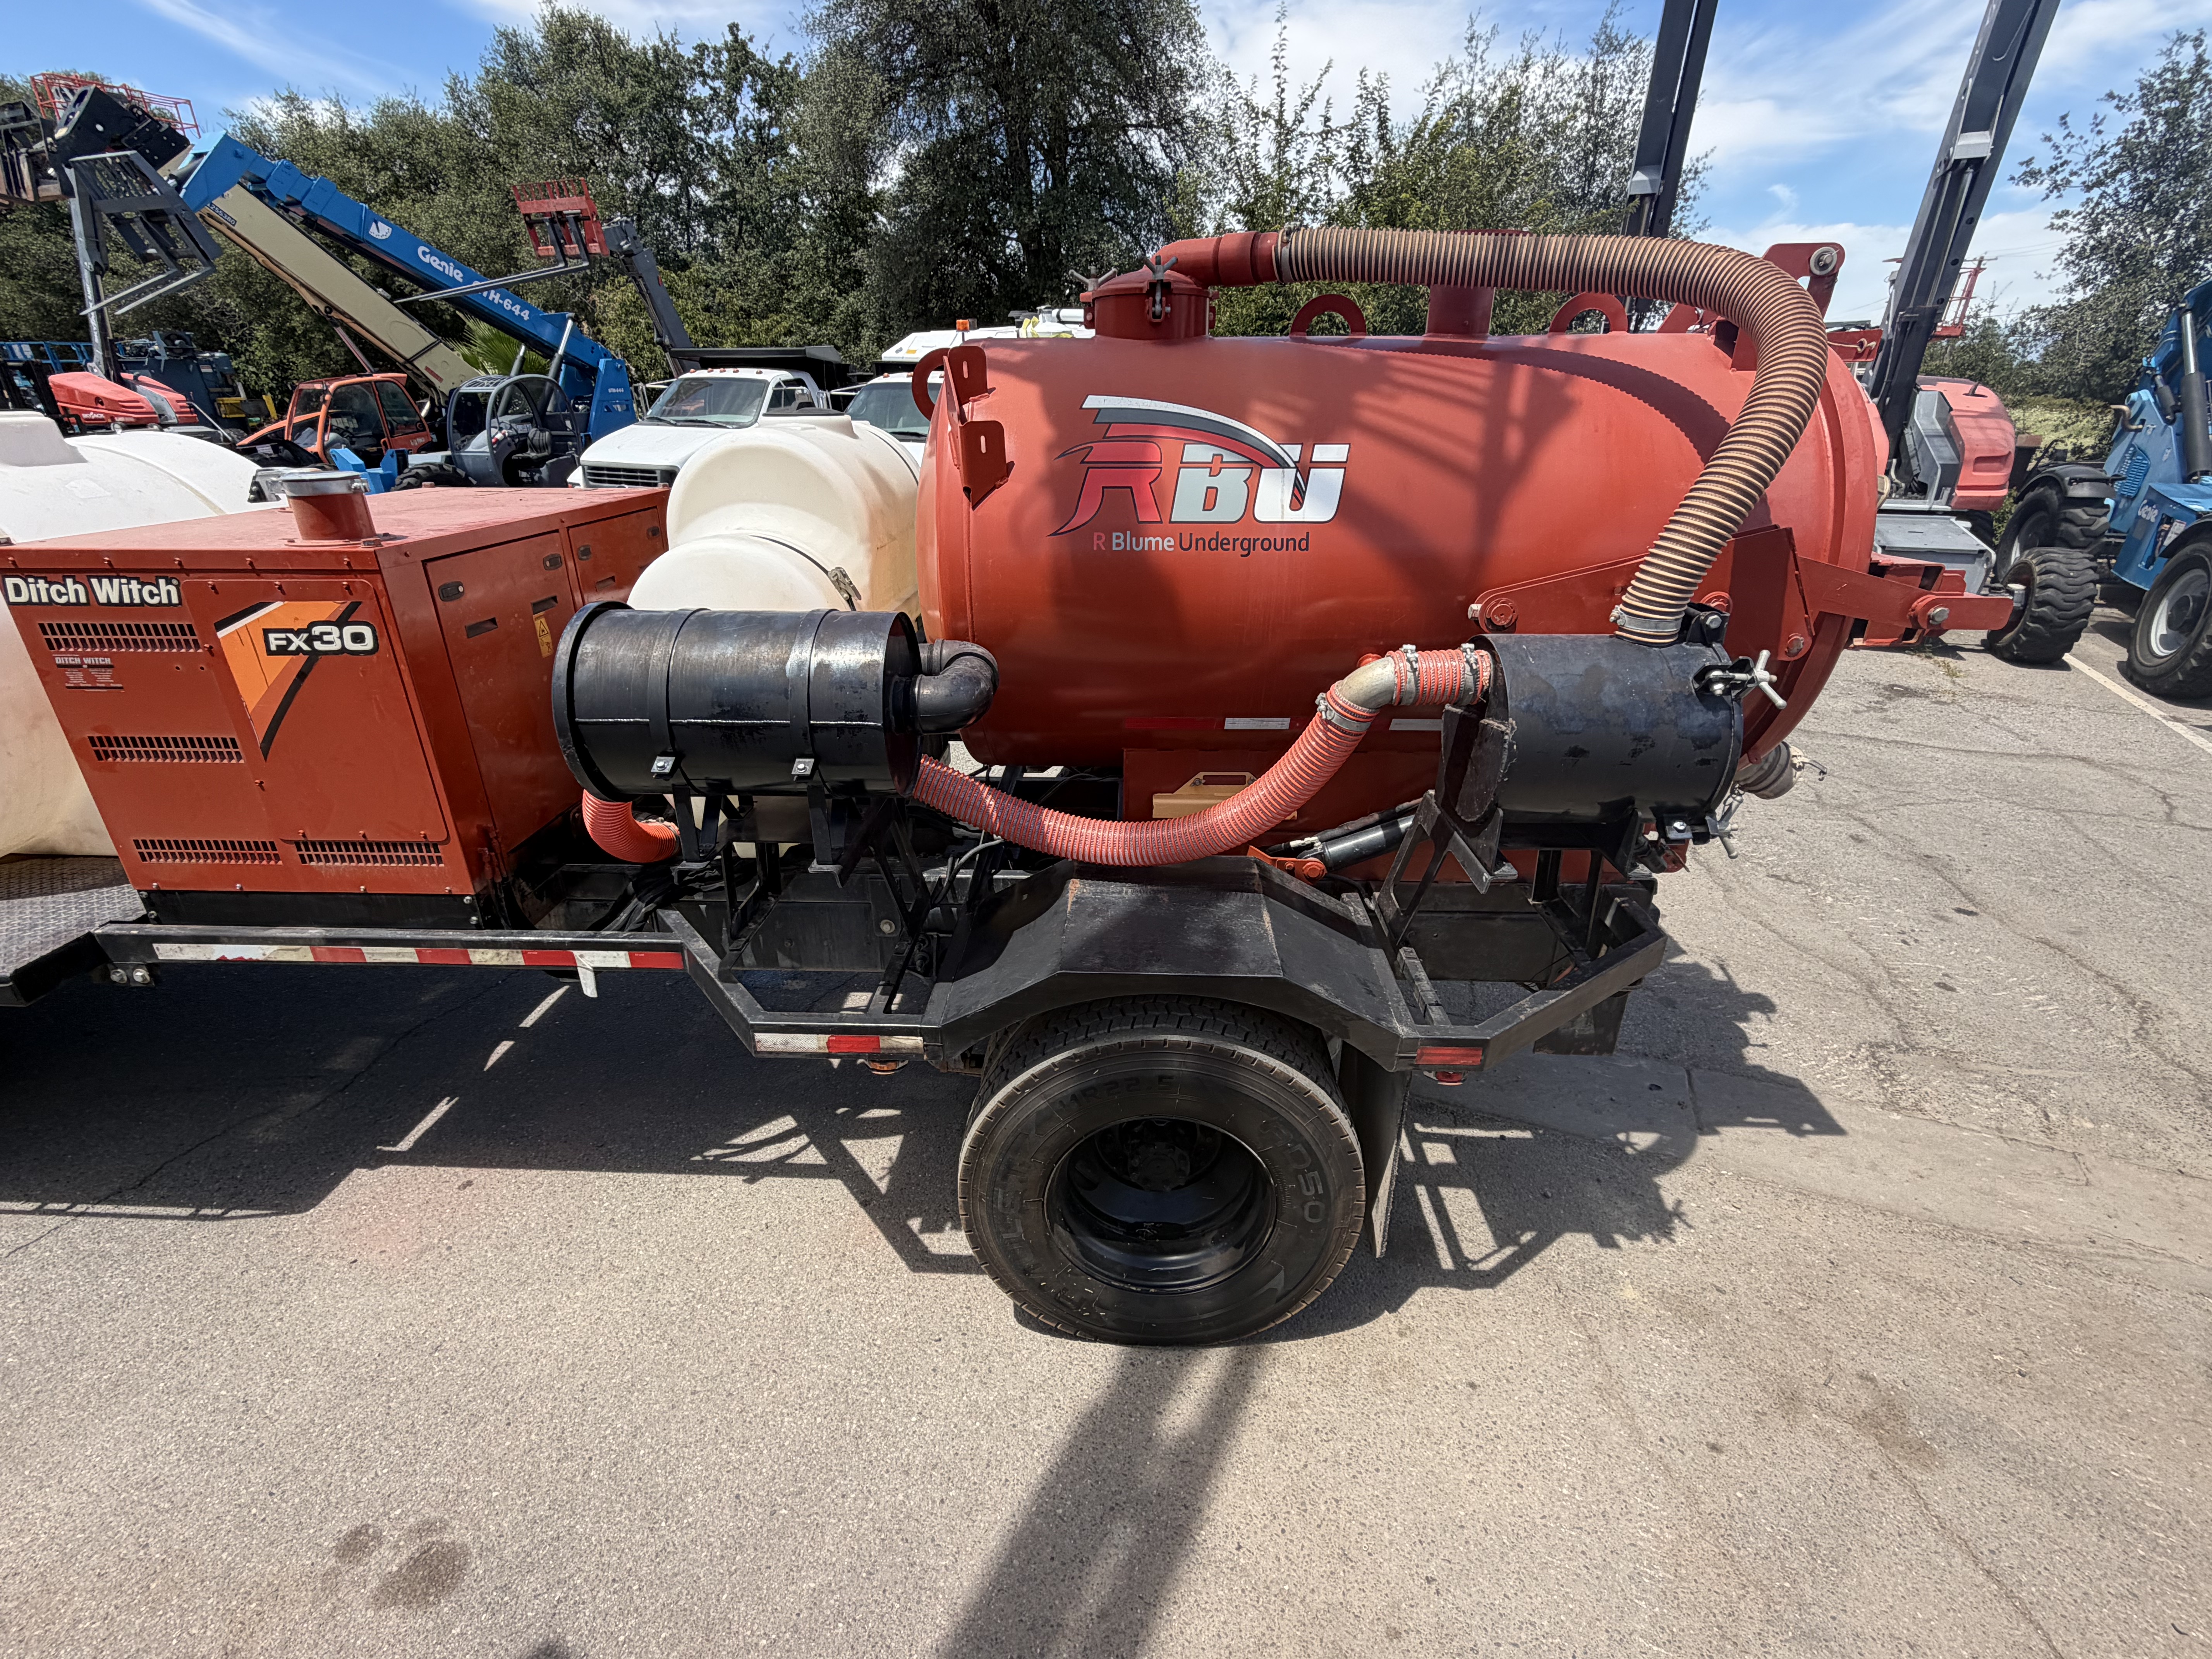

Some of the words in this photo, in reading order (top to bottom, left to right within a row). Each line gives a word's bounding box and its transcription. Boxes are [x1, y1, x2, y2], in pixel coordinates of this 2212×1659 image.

[417, 246, 464, 283] Genie
[472, 281, 530, 321] TH-644
[1047, 440, 1351, 537] RBU
[1093, 532, 1106, 550] R
[1112, 531, 1175, 551] Blume
[1179, 531, 1310, 558] Underground
[5, 577, 87, 603] Ditch
[90, 578, 179, 604] Witch
[268, 625, 374, 651] FX30
